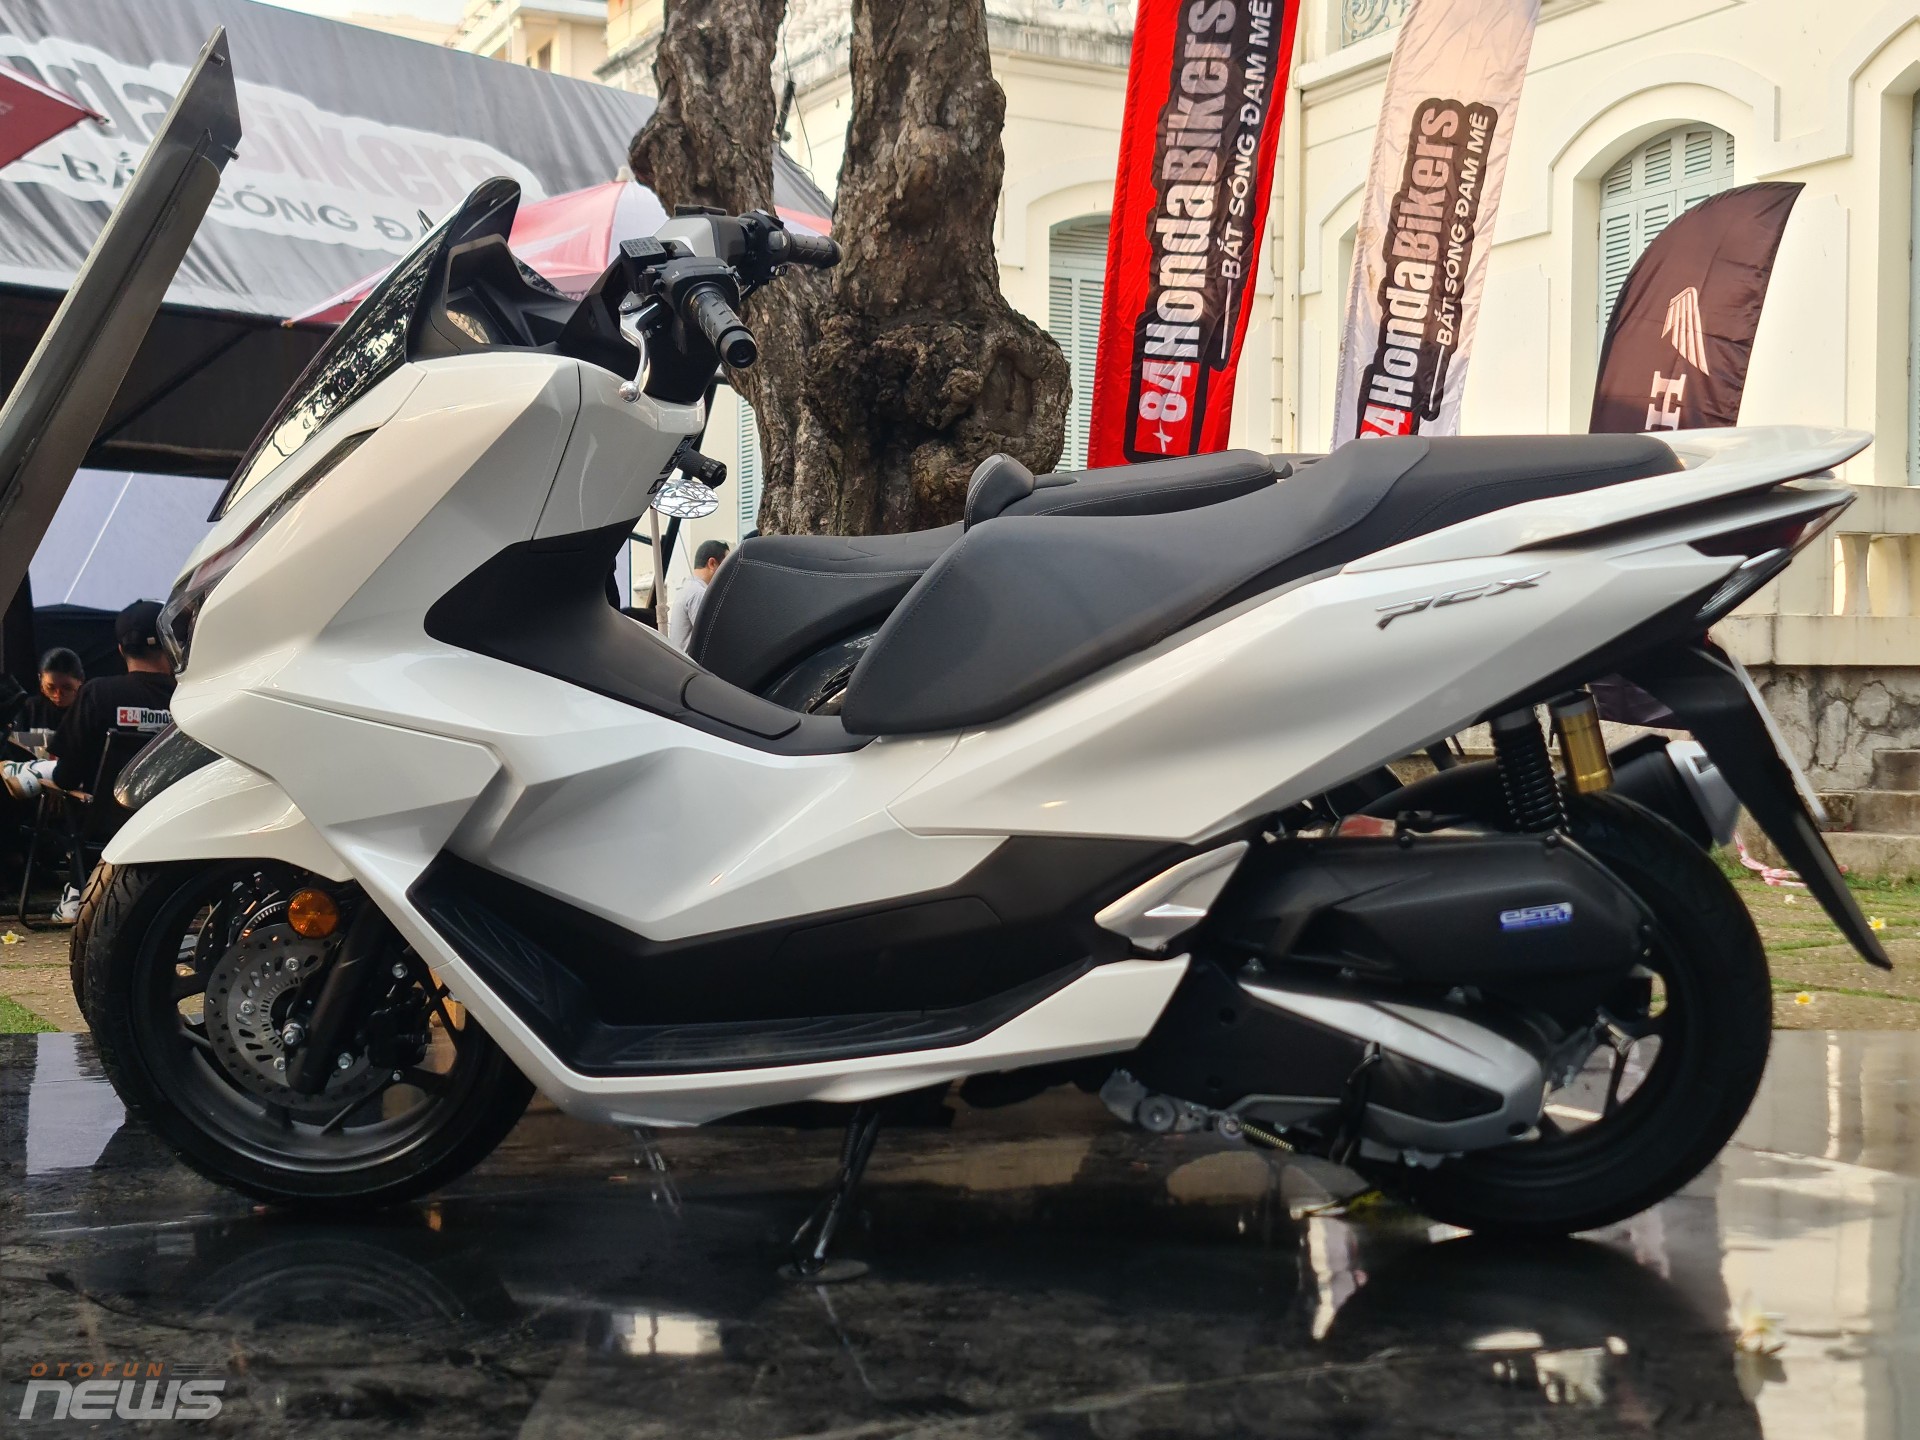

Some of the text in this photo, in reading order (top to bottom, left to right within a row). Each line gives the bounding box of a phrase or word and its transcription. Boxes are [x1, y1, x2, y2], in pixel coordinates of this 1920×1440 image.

[1217, 0, 1272, 280] BẮT SÓNG ĐAM MÊ
[1467, 112, 1488, 154] MÊ
[1454, 157, 1480, 218] ĐAM
[1360, 107, 1459, 439] 4HondaBikers
[1443, 223, 1466, 295] SÓNG
[127, 708, 173, 724] 84Hond
